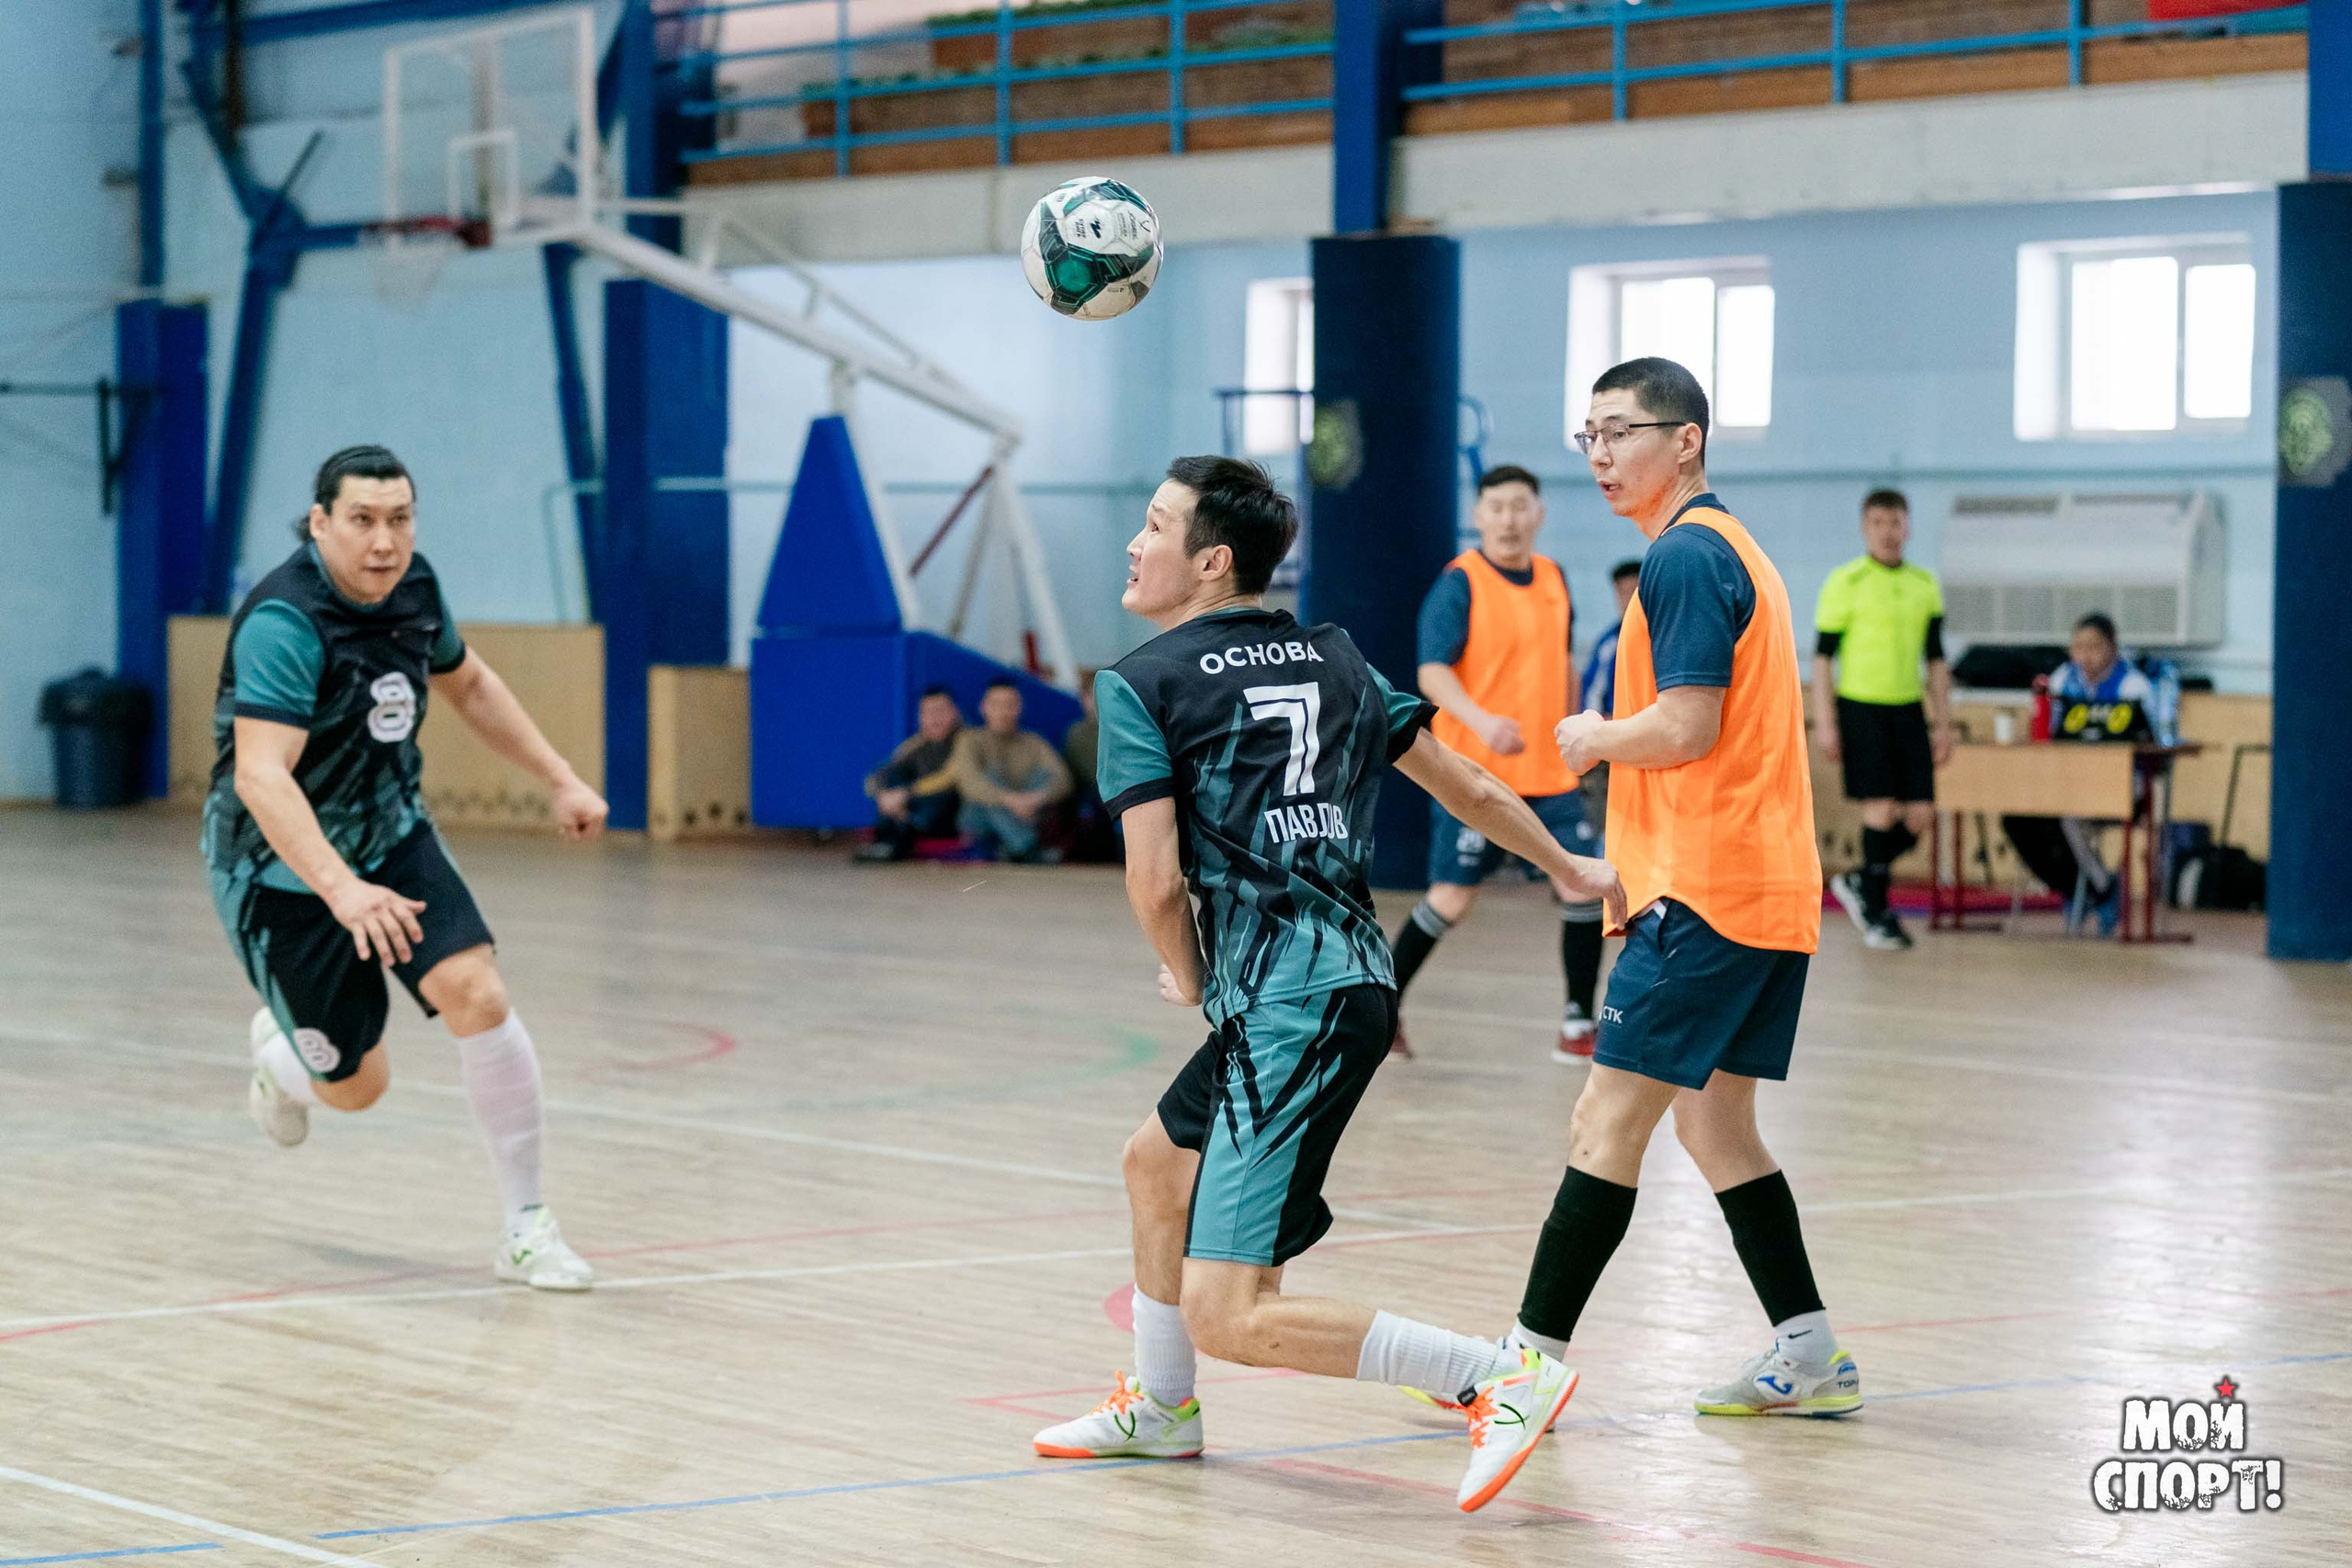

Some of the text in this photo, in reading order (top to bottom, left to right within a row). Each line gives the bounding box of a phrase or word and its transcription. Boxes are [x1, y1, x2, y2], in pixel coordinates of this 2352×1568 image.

[1199, 641, 1324, 674] ОСНОВА
[368, 671, 416, 743] 8
[1243, 682, 1320, 796] 7
[293, 1027, 341, 1073] 8
